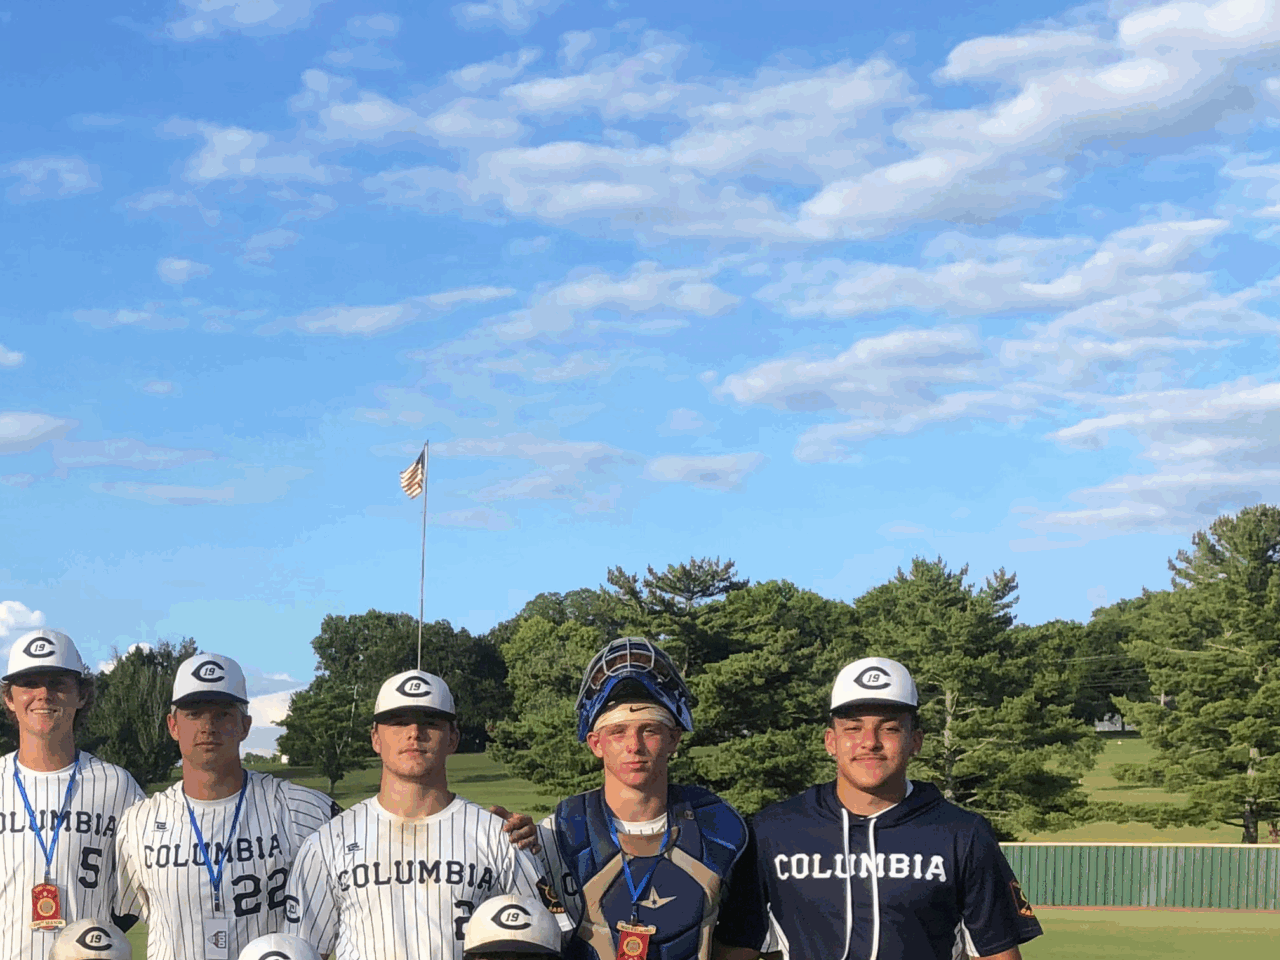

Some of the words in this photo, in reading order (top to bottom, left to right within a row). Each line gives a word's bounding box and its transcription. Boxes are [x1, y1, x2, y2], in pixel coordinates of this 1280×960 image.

[77, 846, 103, 890] 5
[144, 834, 283, 869] COLUMBIA
[774, 852, 948, 883] COLUMBIA
[231, 866, 289, 917] 22
[336, 860, 493, 892] COLUMBIA
